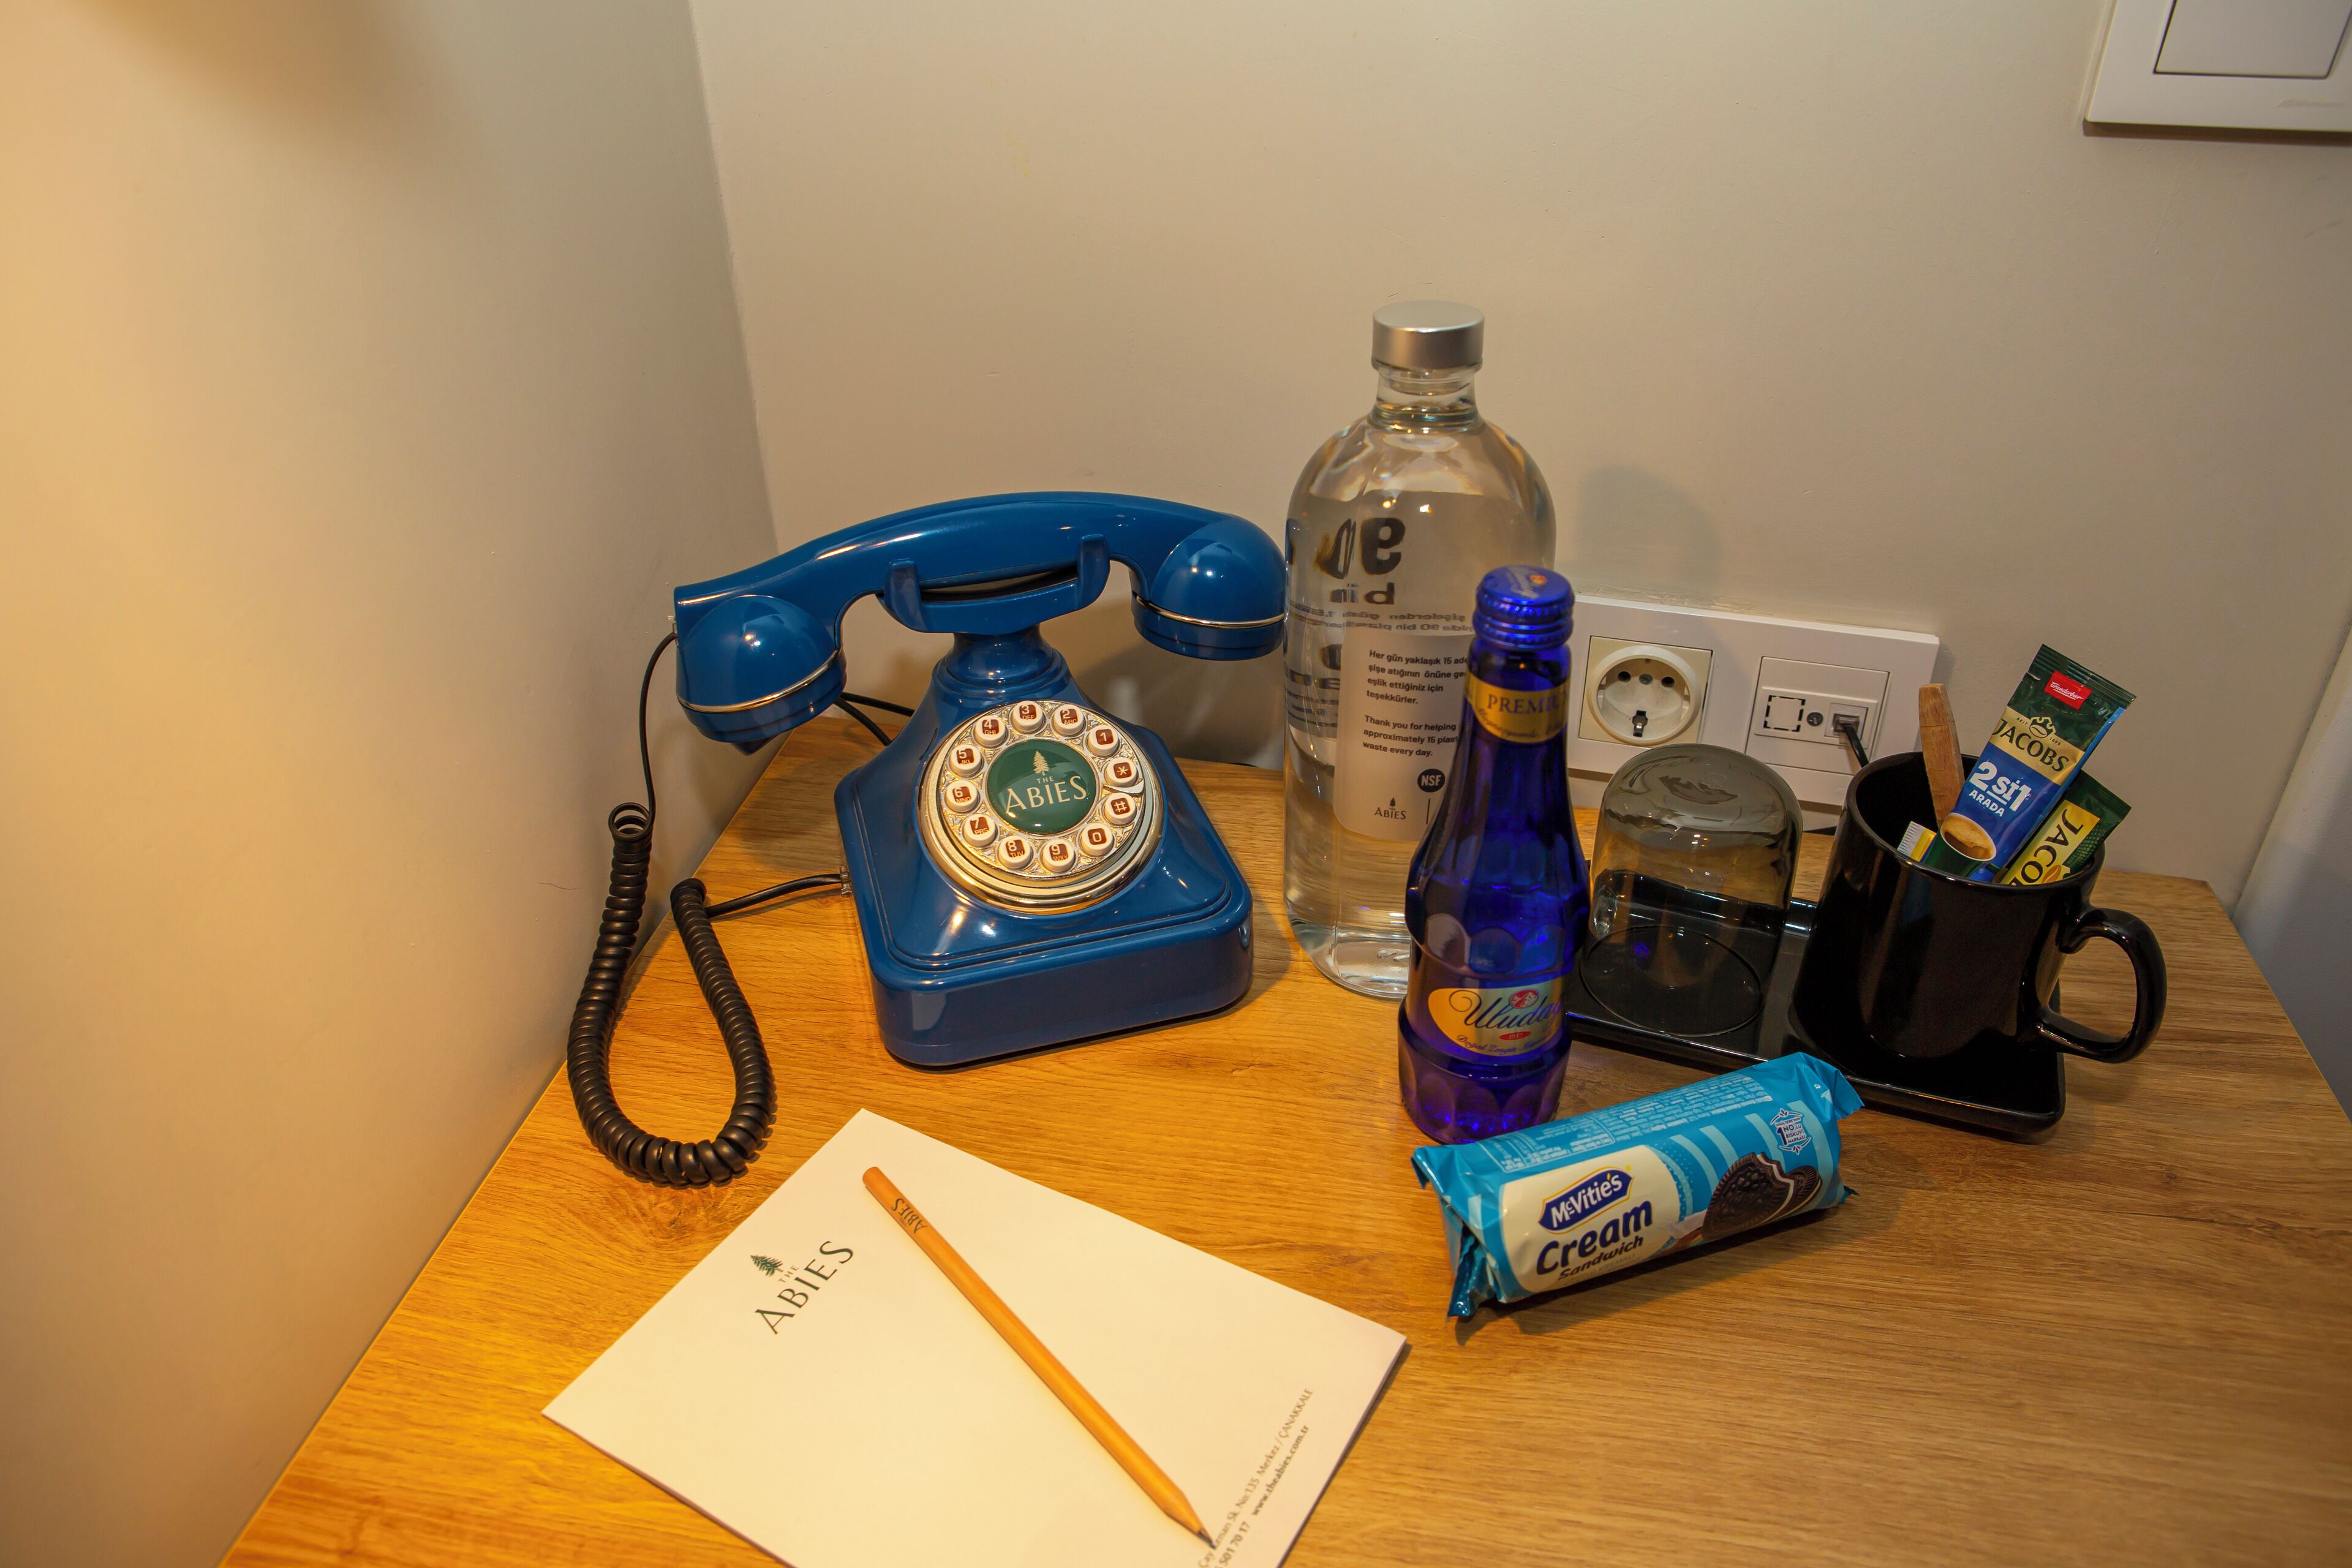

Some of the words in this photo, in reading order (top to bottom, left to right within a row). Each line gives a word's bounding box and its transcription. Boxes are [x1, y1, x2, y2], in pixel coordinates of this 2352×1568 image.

[1369, 650, 1385, 660] Her
[1386, 654, 1403, 663] gün
[1405, 656, 1441, 666] yaklaşık
[1368, 664, 1385, 673] şişe
[1387, 668, 1420, 677] atığının
[1367, 677, 1387, 687] eşlik
[1389, 681, 1425, 692] ettiğiniz
[1427, 684, 1444, 693] için
[1366, 690, 1419, 704] teşekkürler.
[1020, 704, 1030, 715] 3
[1061, 709, 1071, 719] 2
[984, 719, 993, 729] 4
[1365, 715, 1390, 727] Thank
[1424, 723, 1457, 732] helping
[1099, 732, 1108, 742] 1
[1363, 729, 1425, 744] approximately
[1363, 741, 1388, 752] waste
[1390, 747, 1414, 756] every
[1415, 748, 1433, 757] day.
[1992, 718, 2070, 772] JACOBS
[958, 748, 967, 759] 5
[1036, 775, 1054, 784] THE
[1420, 774, 1442, 786] NSF
[954, 787, 963, 797] 6
[1006, 775, 1087, 814] ABIES
[1968, 789, 2005, 818] ARADA
[1374, 807, 1407, 820] ABIES
[971, 817, 979, 829] 7
[1091, 832, 1101, 842] 0
[1007, 840, 1017, 852] 8
[1051, 844, 1060, 855] 9
[2008, 809, 2084, 885] JACO
[1777, 1126, 1787, 1145] 1
[1550, 1172, 1623, 1228] McVitie's
[891, 1197, 928, 1234] ABIES
[1536, 1200, 1653, 1275] Cream
[1558, 1235, 1644, 1280] Sandwich
[777, 1265, 800, 1284] THE
[754, 1240, 854, 1335] ABIES
[1256, 1445, 1280, 1476] Merkez
[1278, 1388, 1314, 1439] ÇANAKKALE
[1230, 1533, 1243, 1547] 70
[1239, 1520, 1251, 1533] 17
[1251, 1425, 1310, 1517] www.theabies.com.tr
